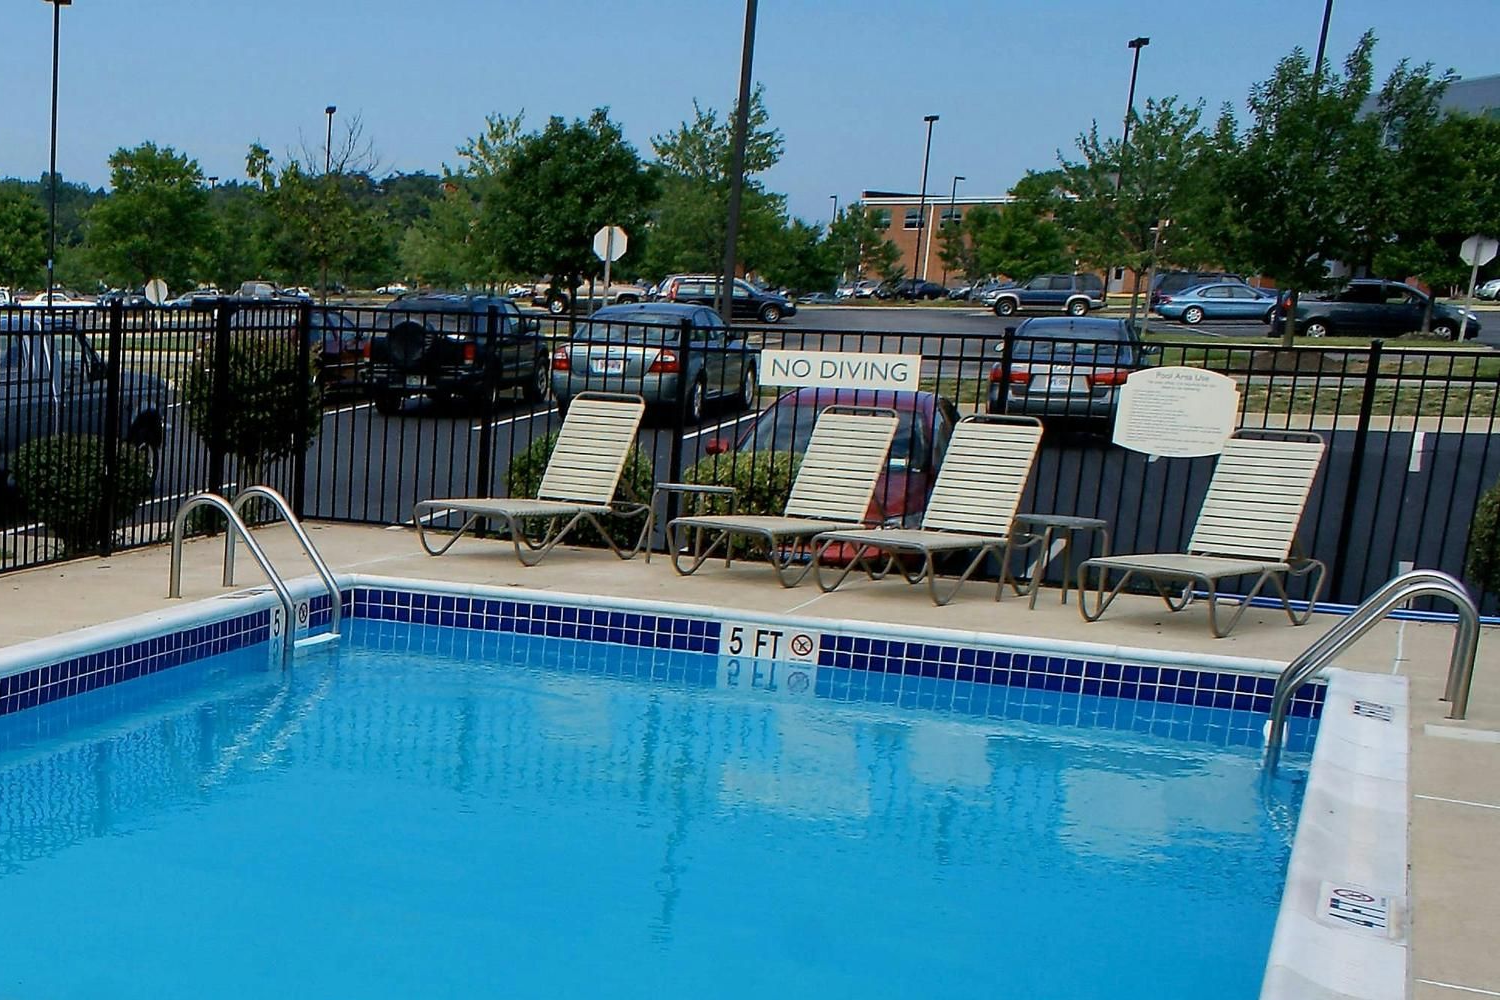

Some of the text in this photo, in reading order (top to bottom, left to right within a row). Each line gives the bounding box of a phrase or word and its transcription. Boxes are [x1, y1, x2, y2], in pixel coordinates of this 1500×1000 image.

[771, 359, 908, 382] NO DIVING
[1156, 371, 1173, 379] Pool
[729, 627, 783, 659] 5 FT
